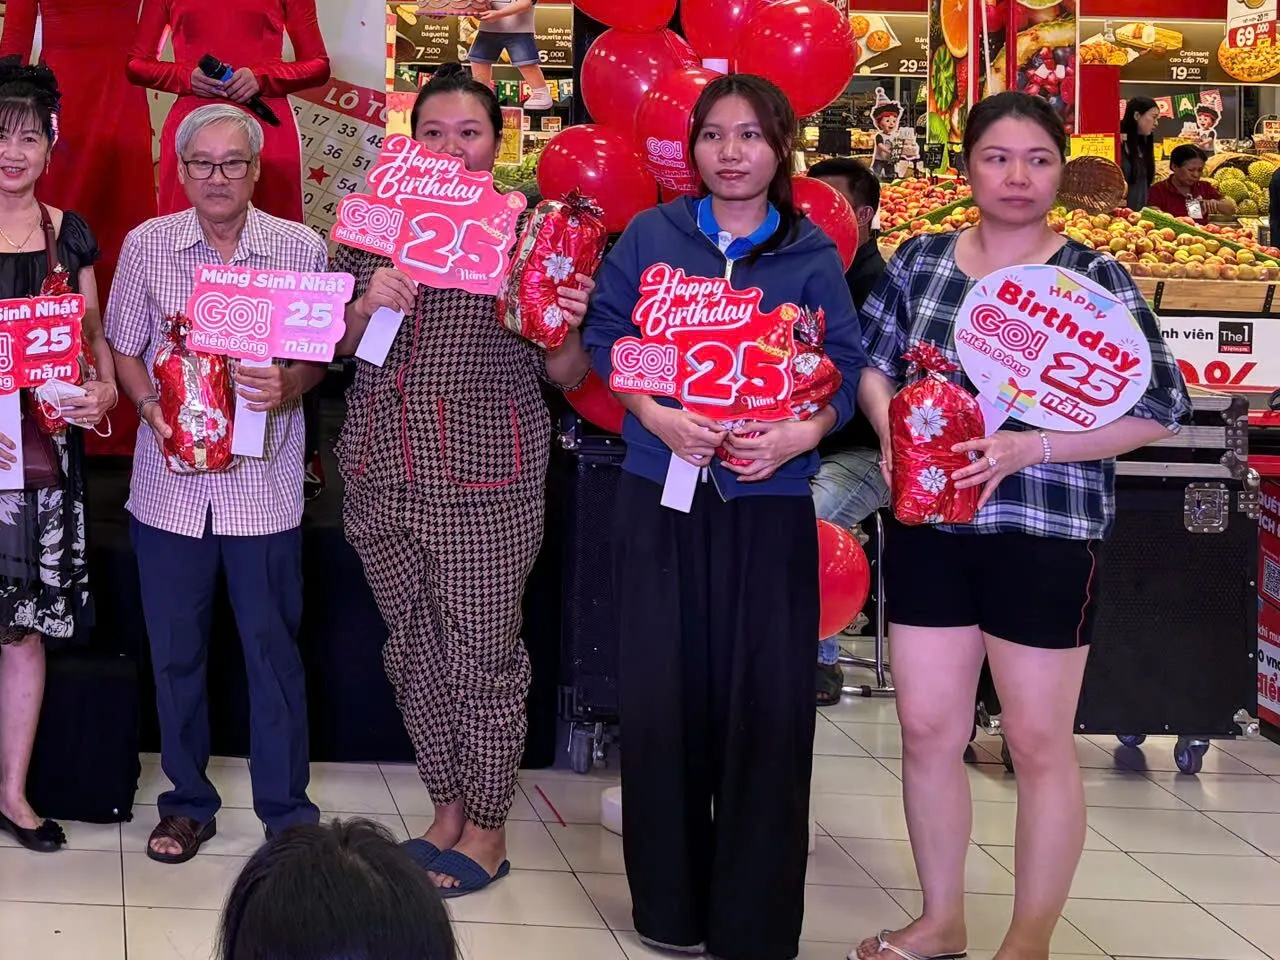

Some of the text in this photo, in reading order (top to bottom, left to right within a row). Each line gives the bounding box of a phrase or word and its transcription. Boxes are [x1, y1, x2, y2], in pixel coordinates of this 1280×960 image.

[421, 31, 449, 39] baguette
[324, 87, 360, 110] LÔ
[312, 113, 330, 127] 17
[337, 123, 358, 138] 33
[322, 144, 343, 159] 36
[352, 155, 372, 171] 51
[380, 135, 489, 183] Happy
[647, 136, 683, 160] GO!
[337, 178, 357, 193] 54
[369, 162, 484, 206] Birthday
[340, 198, 404, 240] GO!
[365, 234, 396, 254] Đông
[399, 212, 508, 278] 25
[253, 272, 296, 290] Sinh
[299, 276, 347, 297] Nhật
[456, 266, 488, 282] Năm
[638, 265, 757, 302] Happy
[35, 299, 79, 318] Nhật
[194, 291, 273, 338] GO!
[284, 300, 334, 328] 25
[634, 294, 754, 340] Birthday
[1048, 285, 1107, 321] HAPPY
[970, 303, 1049, 362] GO!
[996, 279, 1141, 373] Birthday
[1183, 328, 1214, 340] viên
[25, 326, 72, 356] 25
[228, 338, 269, 356] Đông
[284, 337, 329, 355] năm
[29, 363, 72, 381] năm
[614, 340, 679, 379] GO!
[991, 348, 1032, 379] Đông
[643, 377, 676, 394] Đông
[682, 341, 789, 407] 25
[1040, 351, 1130, 407] 25
[741, 395, 776, 410] Năm
[1039, 391, 1097, 428] năm
